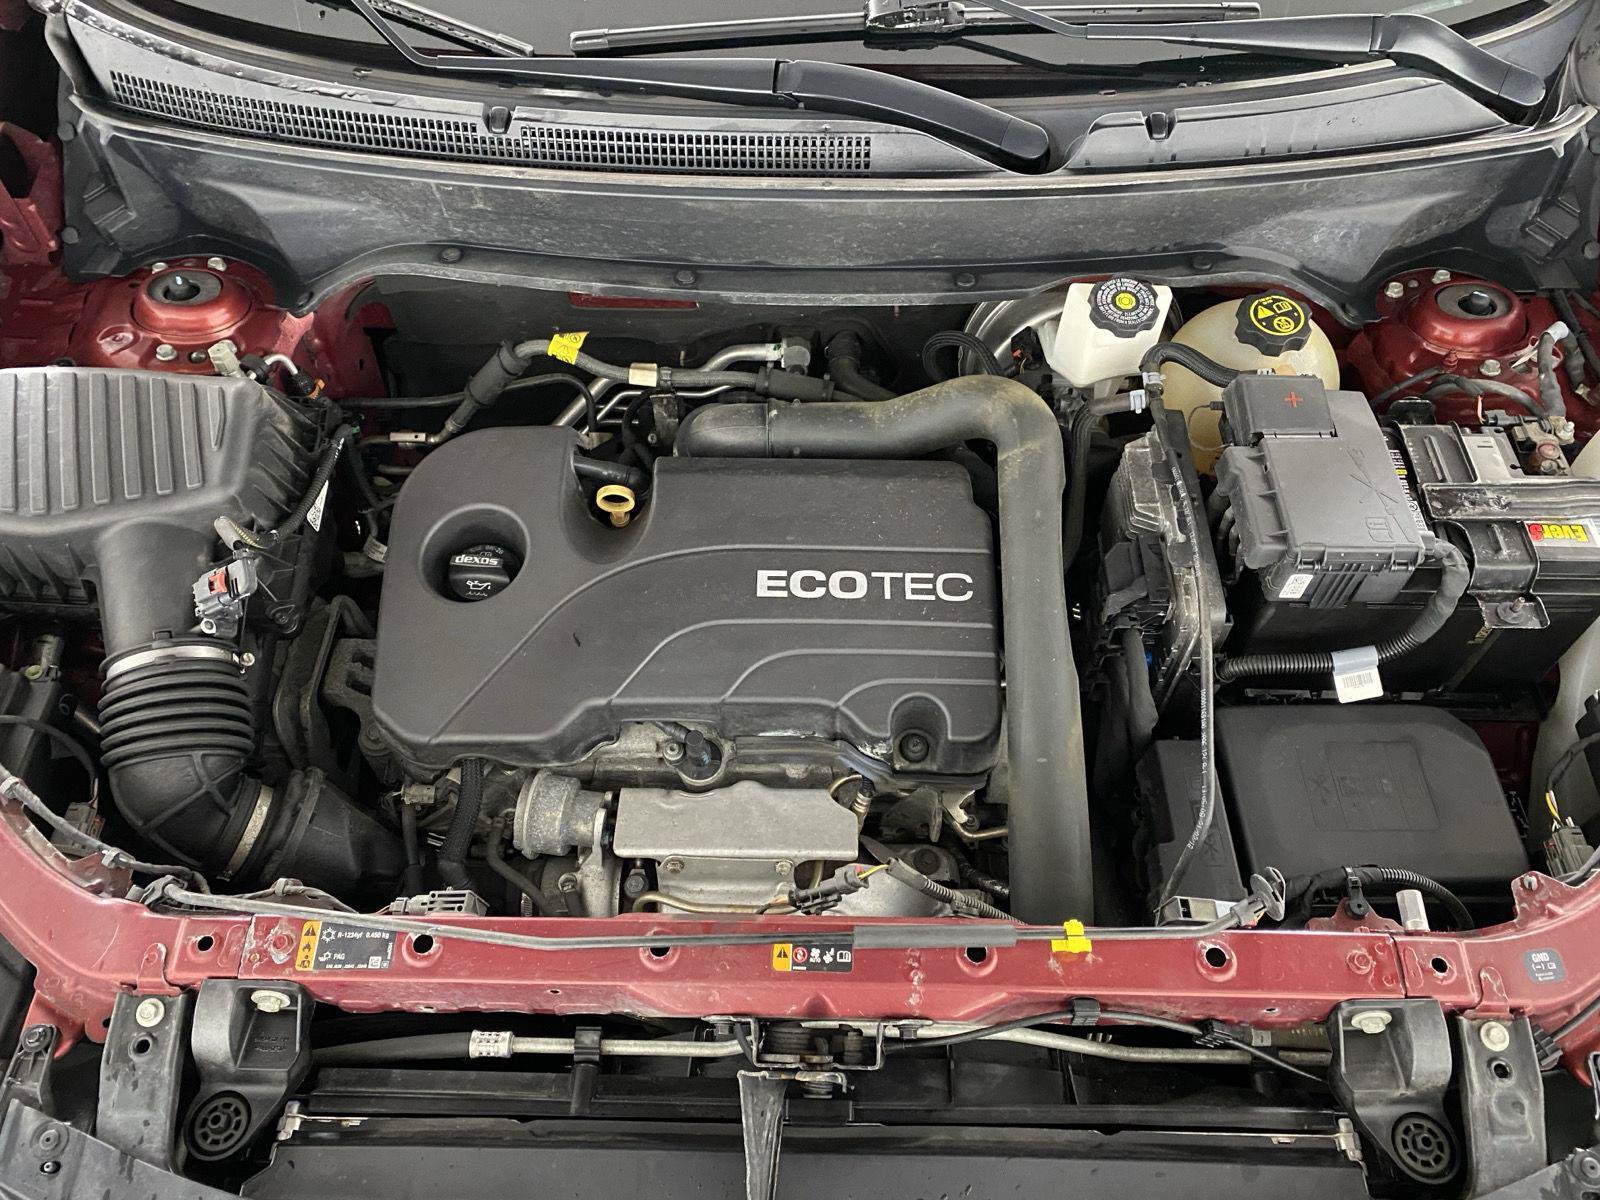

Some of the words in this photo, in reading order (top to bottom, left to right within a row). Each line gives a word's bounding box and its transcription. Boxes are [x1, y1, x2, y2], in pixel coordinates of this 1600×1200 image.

[455, 555, 499, 566] dexos
[756, 569, 974, 602] ECOTEC
[382, 931, 389, 939] kg
[1531, 952, 1550, 963] GND
